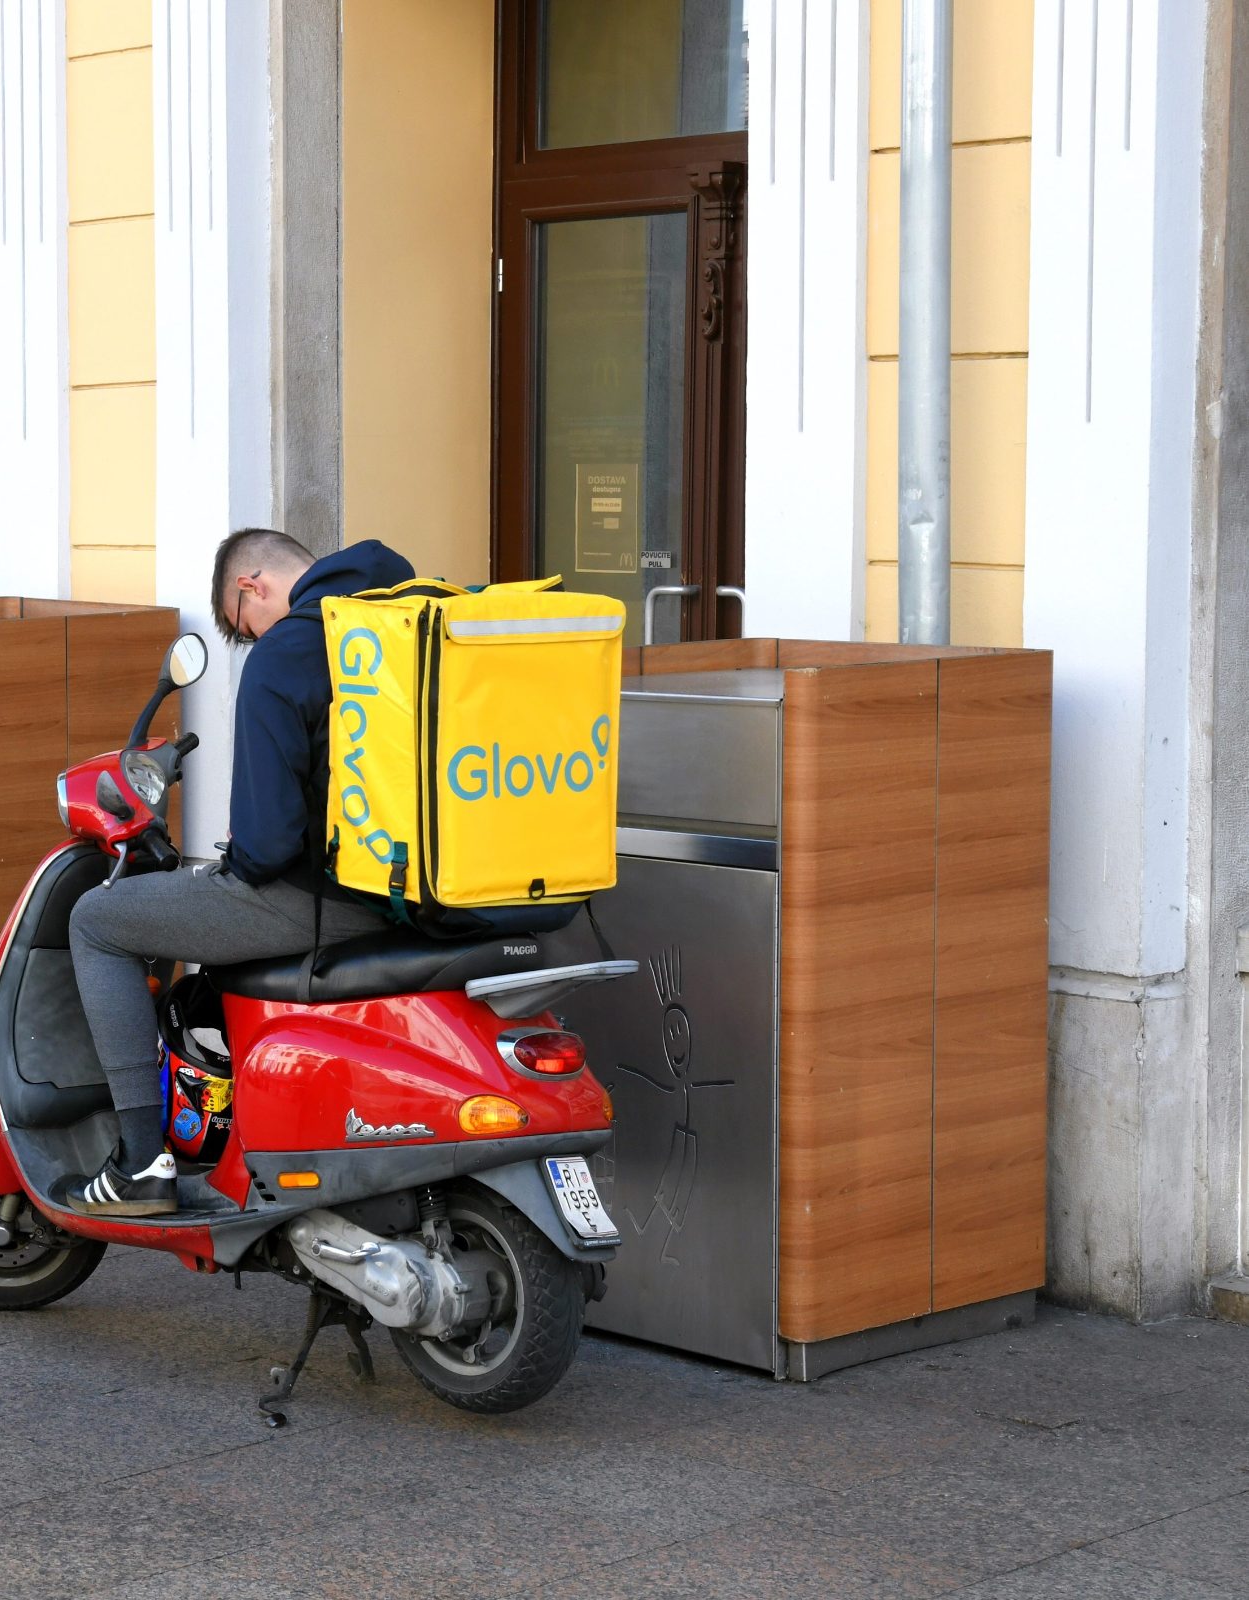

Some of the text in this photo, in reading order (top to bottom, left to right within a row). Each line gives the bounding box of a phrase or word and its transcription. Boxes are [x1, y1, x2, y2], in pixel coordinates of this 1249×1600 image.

[641, 551, 671, 559] POVUCITE
[648, 560, 663, 568] PULL
[338, 626, 383, 828] Glovo
[446, 741, 594, 802] Glovo
[502, 944, 538, 956] PIAGGIO
[562, 1168, 581, 1188] RI
[563, 1188, 599, 1211] 1959
